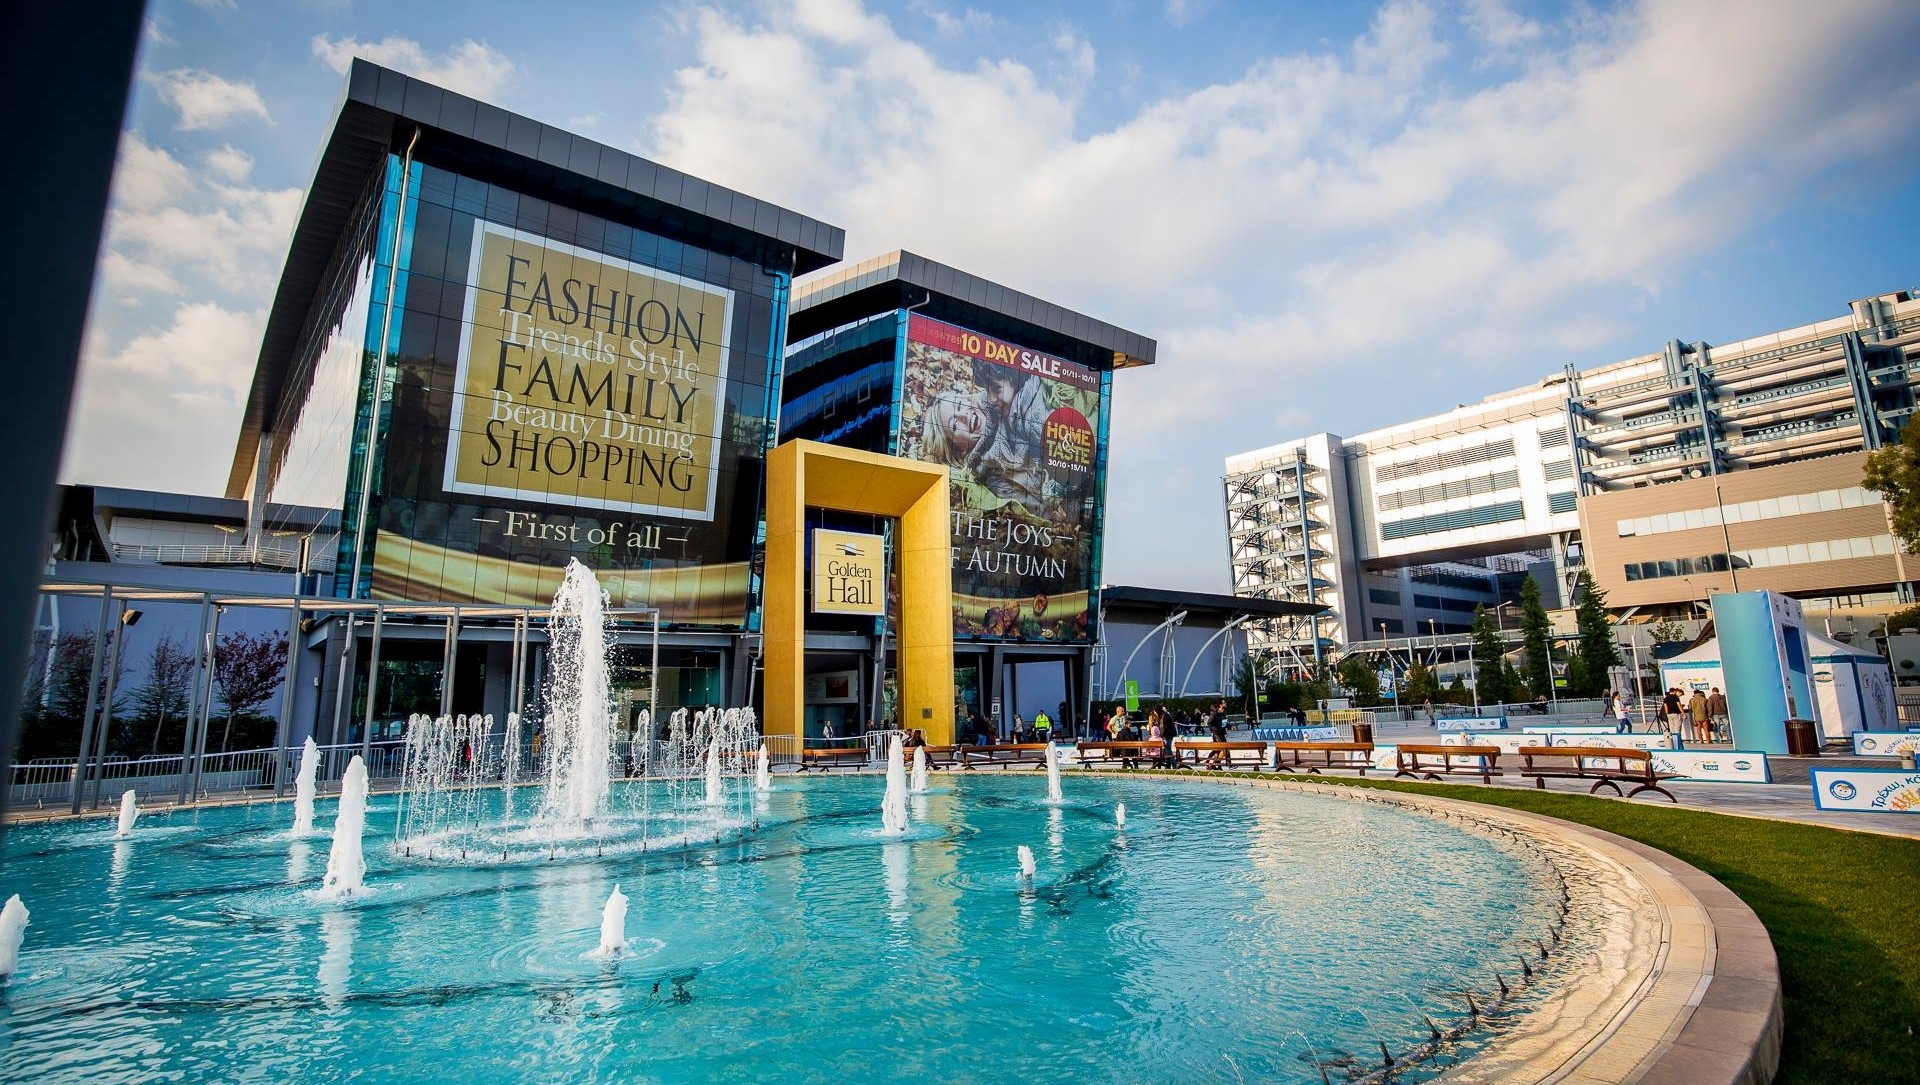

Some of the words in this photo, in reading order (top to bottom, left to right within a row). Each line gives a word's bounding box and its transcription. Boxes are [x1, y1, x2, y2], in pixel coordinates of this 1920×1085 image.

[500, 254, 706, 355] FASHION
[500, 308, 615, 365] Trends
[627, 339, 700, 385] Style
[961, 333, 981, 354] 10
[984, 343, 1020, 365] DAY
[1021, 351, 1061, 378] SALE
[492, 339, 700, 425] FAMILY
[488, 389, 596, 444] Beauty
[601, 409, 697, 461] Dining
[1046, 421, 1091, 446] HOME
[1062, 433, 1076, 453] &
[481, 419, 695, 493] SHOPPING
[1046, 439, 1090, 465] TASTE
[503, 511, 581, 543] First
[587, 522, 623, 546] of
[627, 526, 661, 550] all
[951, 510, 998, 541] THE
[1003, 518, 1052, 549] JOYS
[828, 560, 872, 578] Golden
[950, 546, 961, 569] F
[967, 545, 1067, 579] AUTUMN
[827, 576, 873, 604] Hall
